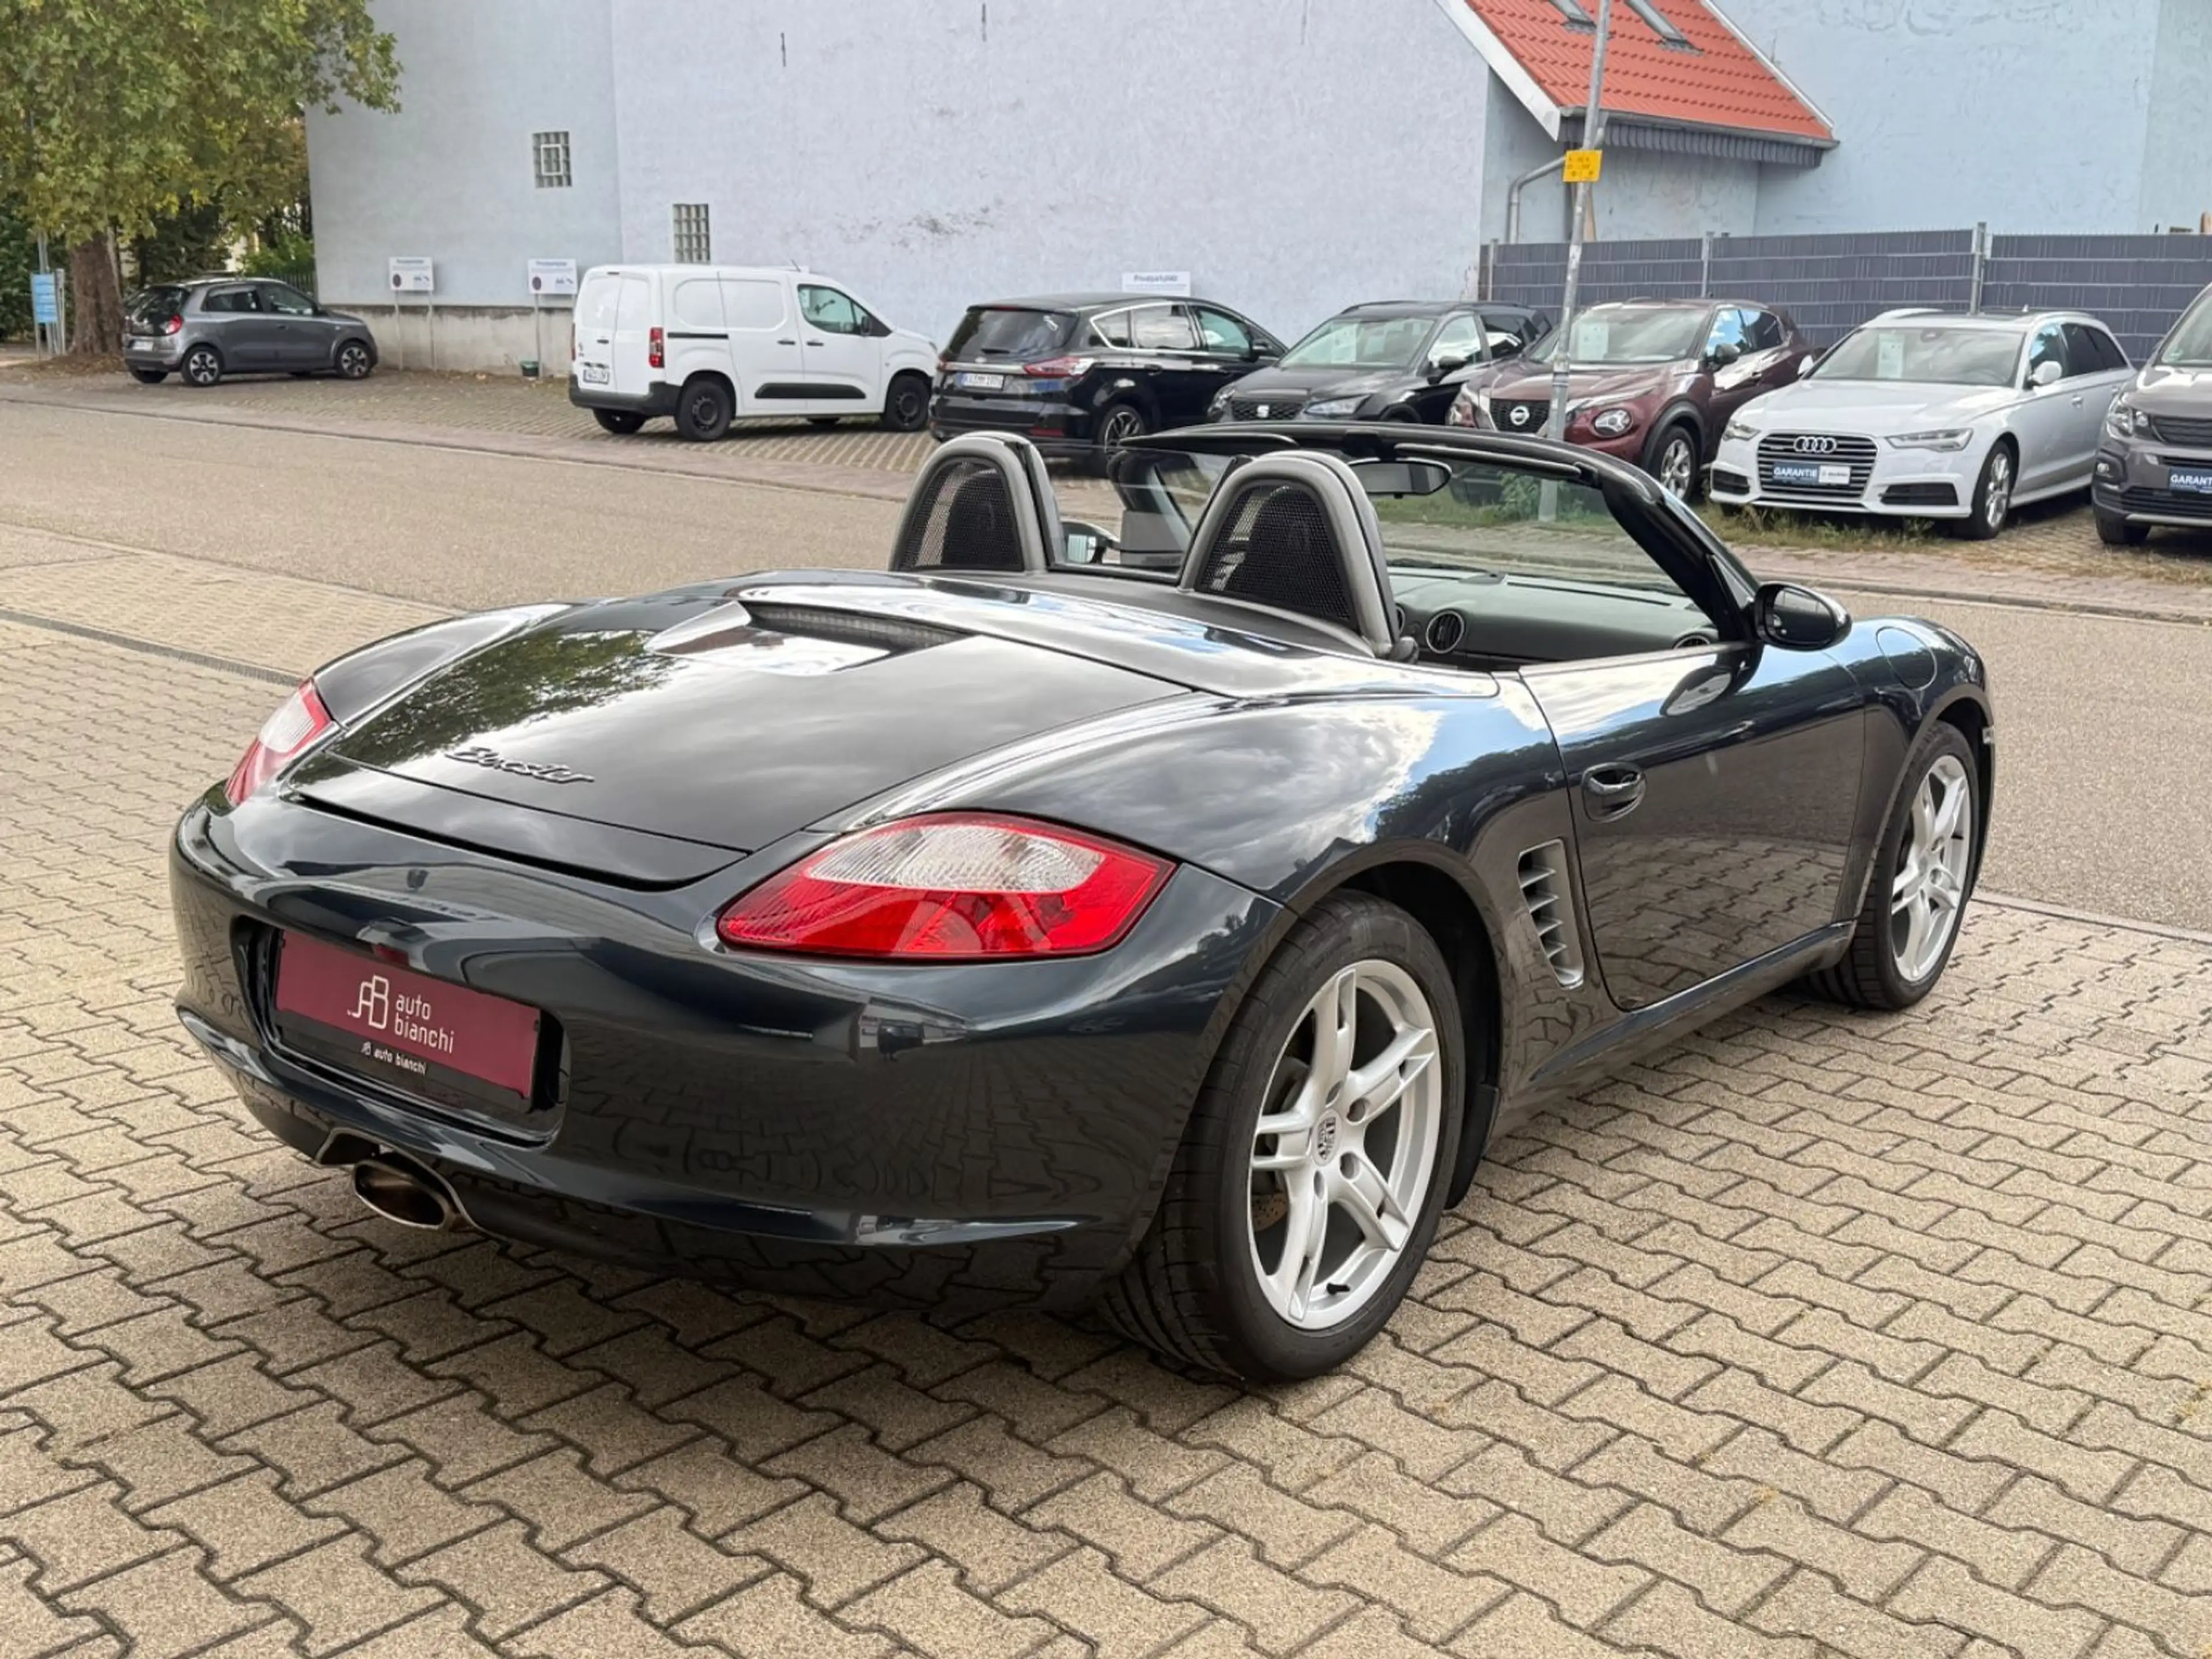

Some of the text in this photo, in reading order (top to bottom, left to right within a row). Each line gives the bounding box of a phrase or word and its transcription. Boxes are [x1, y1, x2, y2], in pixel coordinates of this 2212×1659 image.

[1774, 466, 1817, 477] GARANTIE
[444, 747, 595, 784] Boxster
[395, 994, 431, 1021] auto
[394, 1012, 455, 1054] bianchi
[374, 1048, 393, 1063] auto
[395, 1052, 427, 1076] bianchi
